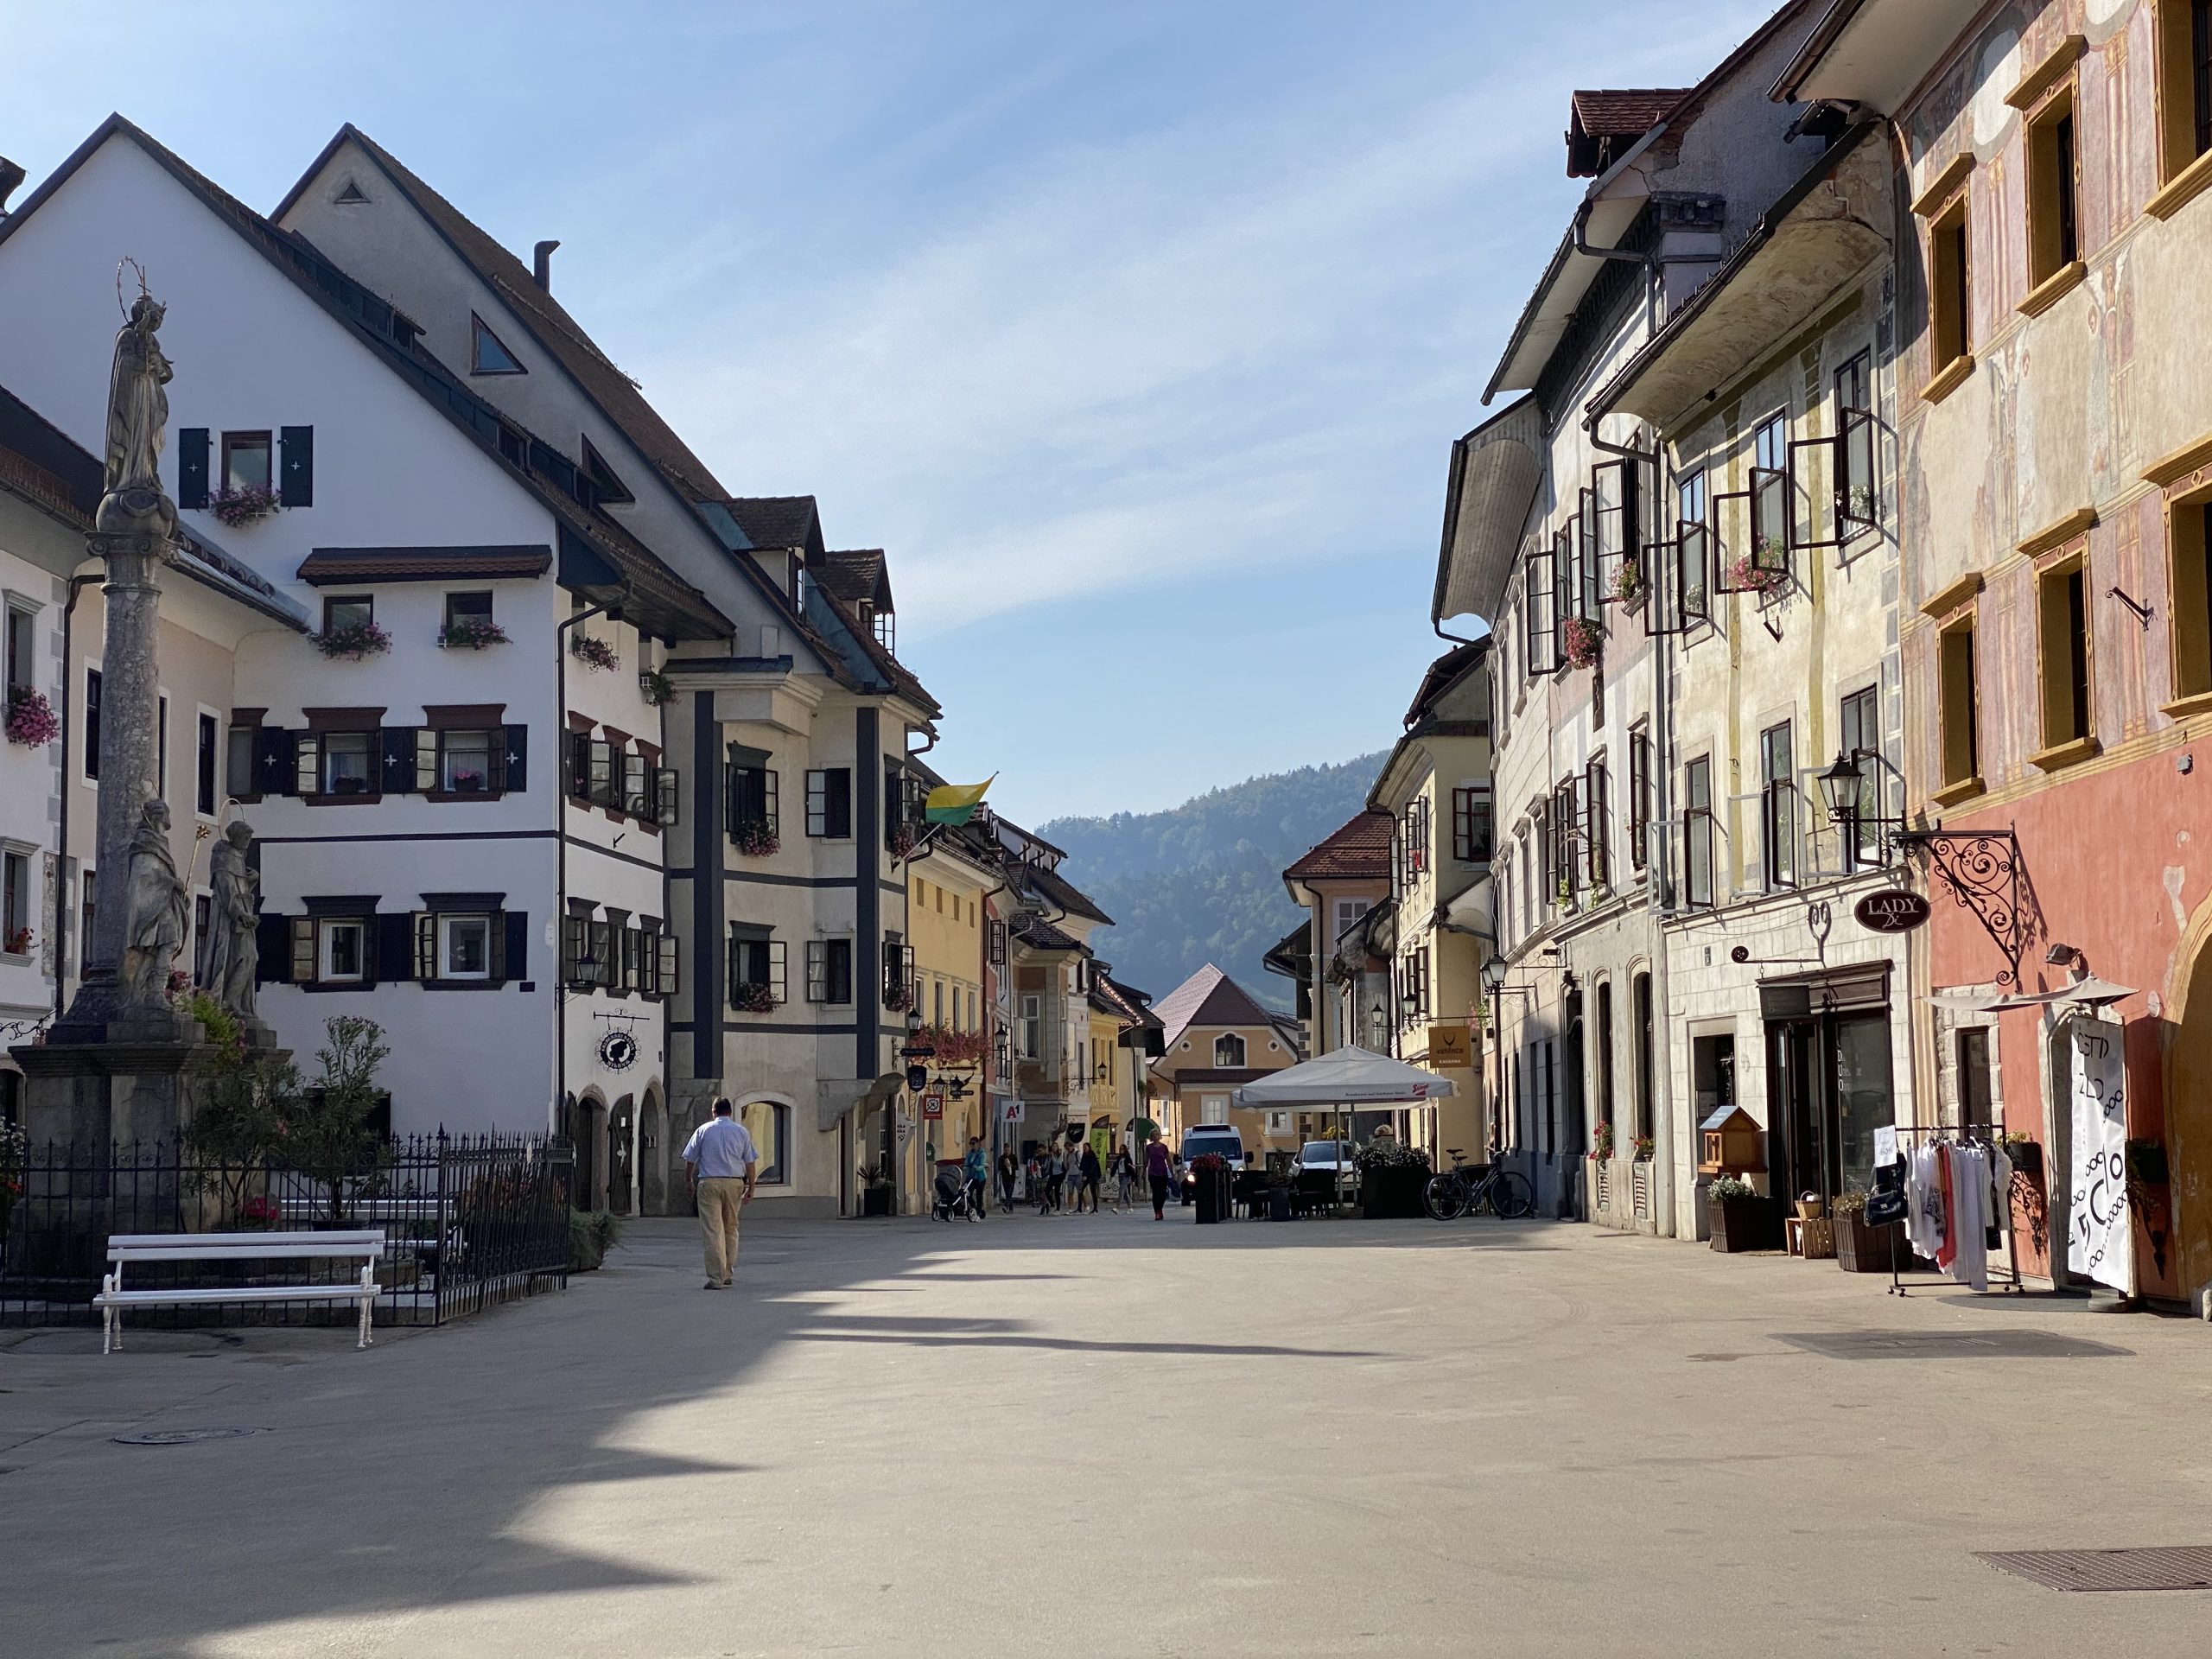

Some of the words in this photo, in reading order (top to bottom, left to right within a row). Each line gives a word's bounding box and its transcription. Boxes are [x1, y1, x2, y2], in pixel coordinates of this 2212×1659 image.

[1868, 898, 1917, 913] LADY
[1882, 912, 1904, 929] Di
[1006, 1104, 1020, 1119] A1
